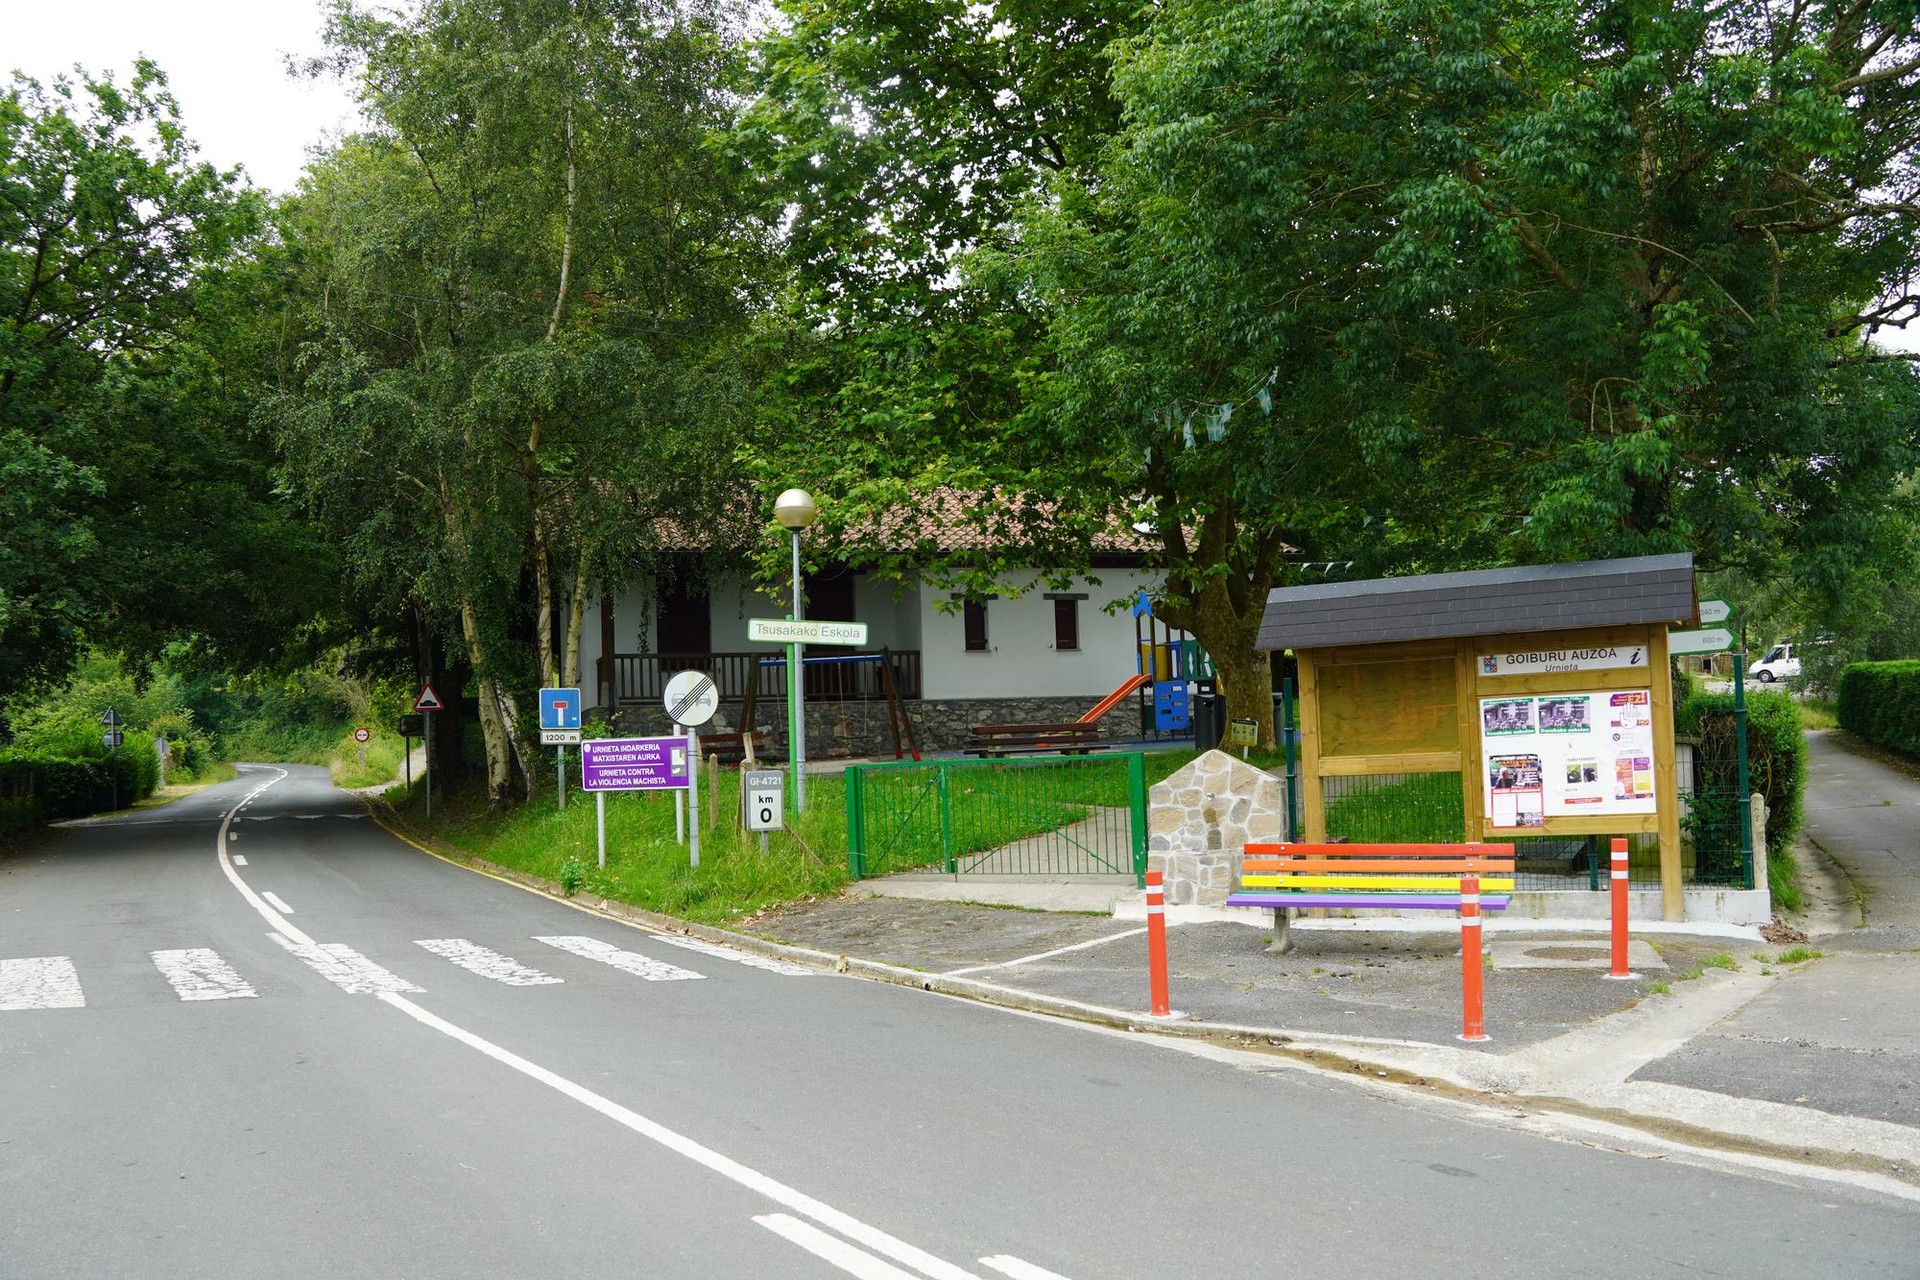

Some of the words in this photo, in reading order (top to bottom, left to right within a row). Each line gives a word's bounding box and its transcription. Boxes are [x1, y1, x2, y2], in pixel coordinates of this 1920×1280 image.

[756, 623, 817, 637] Tsusakako
[821, 626, 860, 638] Eskola
[1506, 651, 1566, 664] GOIBURU
[1571, 648, 1617, 661] AUZOA
[1545, 663, 1579, 672] Urnieta
[592, 745, 619, 753] URNIETA
[620, 743, 660, 752] INDARKERIA
[592, 754, 637, 762] MATXISTAREN
[599, 769, 626, 777] URNIETA
[597, 778, 632, 786] VIOLENCIA
[633, 777, 666, 785] MACHISTA
[750, 776, 782, 786] GI-4721
[758, 795, 773, 803] km
[760, 808, 772, 823] 0
